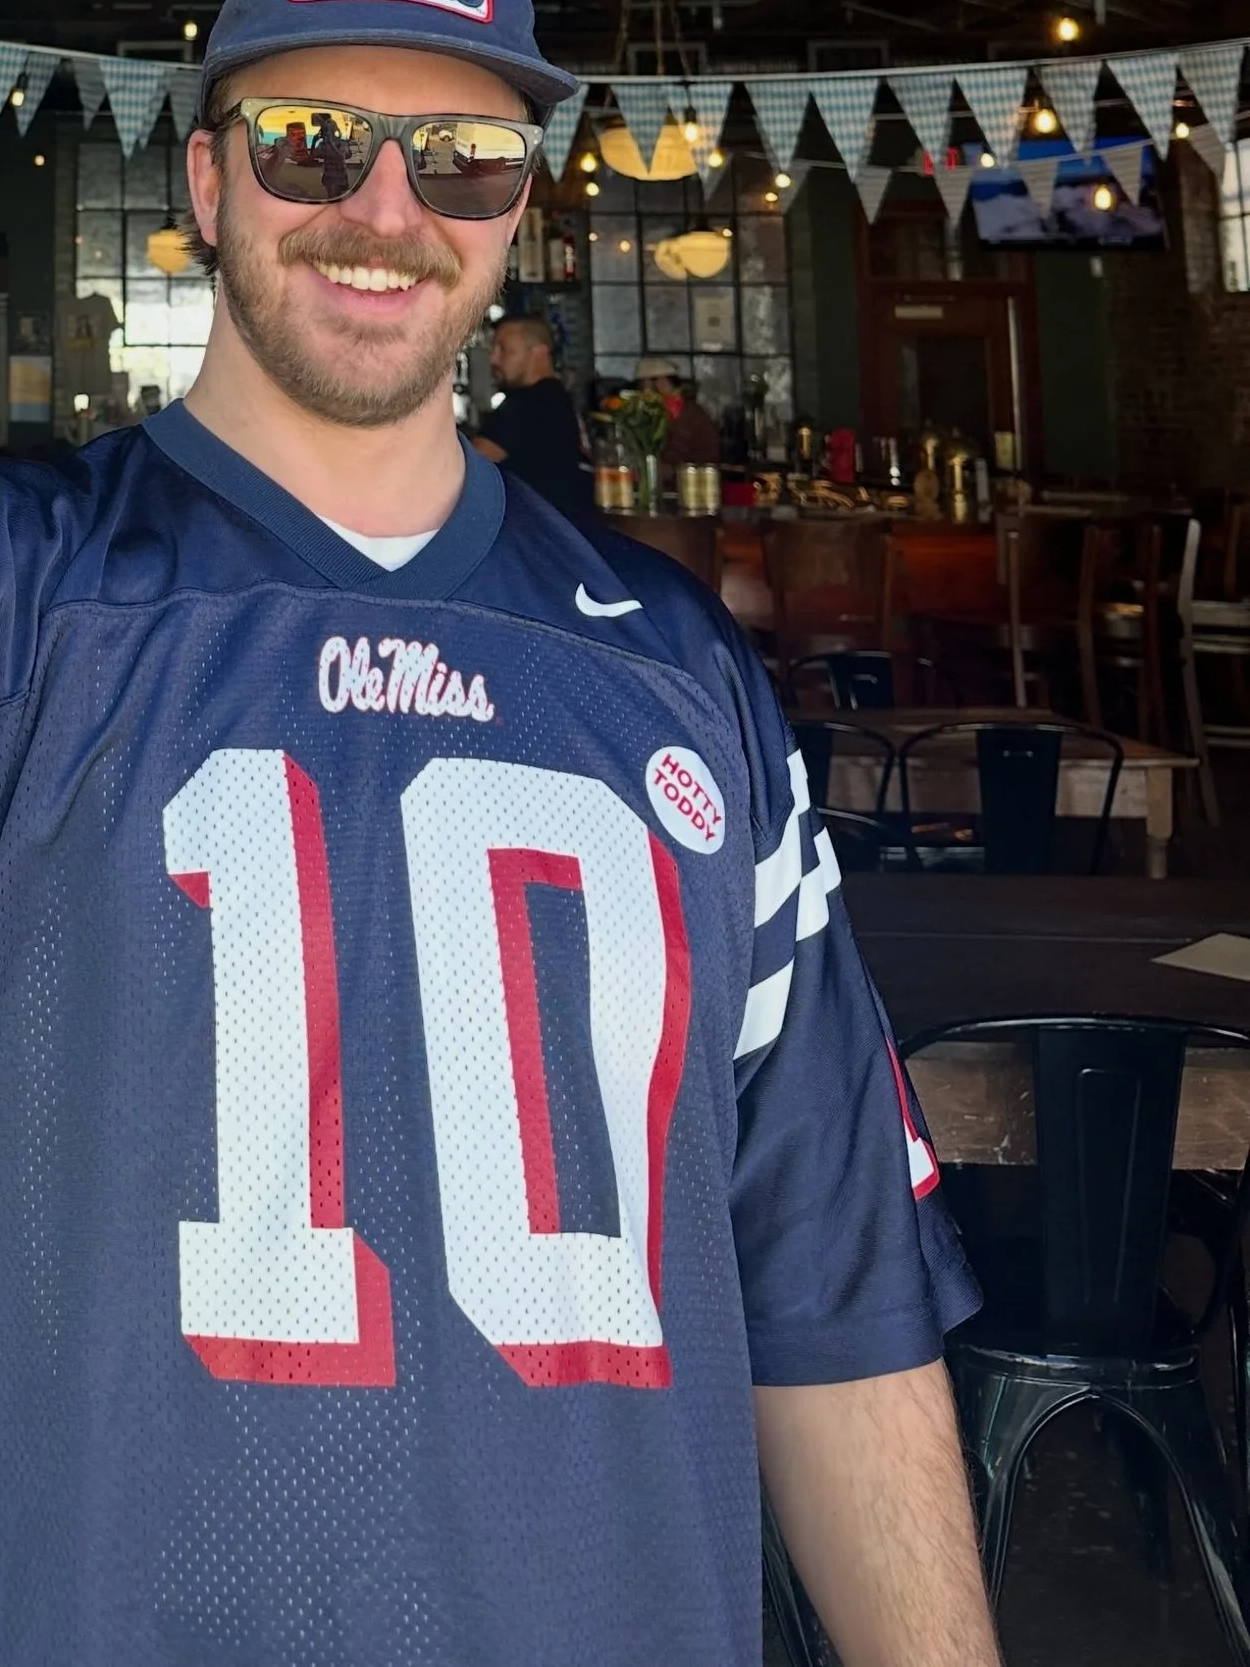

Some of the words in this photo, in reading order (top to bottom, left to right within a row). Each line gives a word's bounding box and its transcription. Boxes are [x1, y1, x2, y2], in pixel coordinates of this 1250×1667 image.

[318, 635, 385, 713] Ole
[378, 637, 495, 722] Miss
[654, 769, 715, 841] TODDY
[661, 754, 722, 824] HOTTY
[163, 748, 692, 1387] 10
